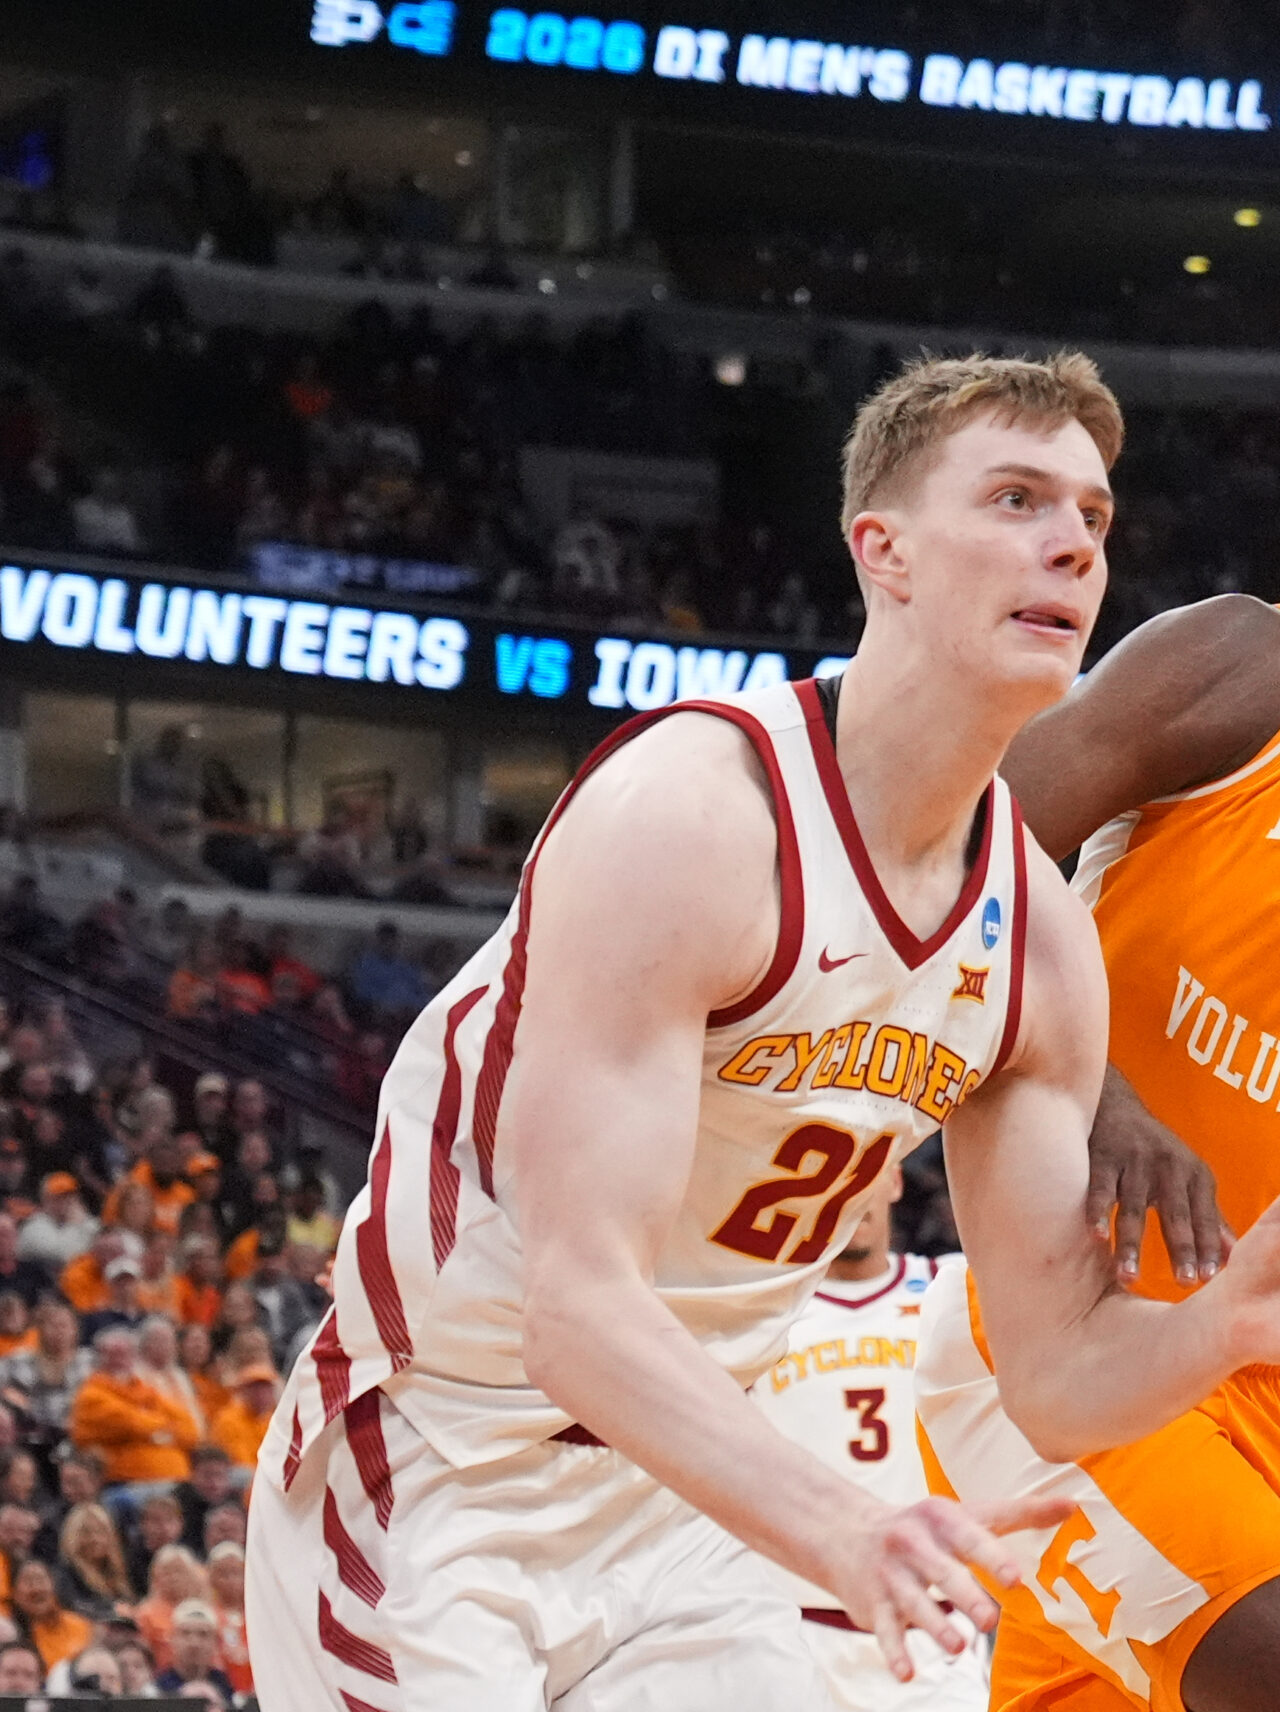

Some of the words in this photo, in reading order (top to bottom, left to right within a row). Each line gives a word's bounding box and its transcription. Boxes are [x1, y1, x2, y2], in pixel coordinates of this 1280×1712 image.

[486, 7, 647, 75] 2026
[653, 25, 730, 84] DI
[736, 33, 911, 102] MEN'S
[919, 54, 1271, 133] BASKETBALL
[0, 566, 469, 690] VOLUNTEERS
[495, 633, 573, 698] VS
[588, 637, 788, 711] IOWA
[707, 1120, 897, 1264] 21
[844, 1387, 890, 1462] 3
